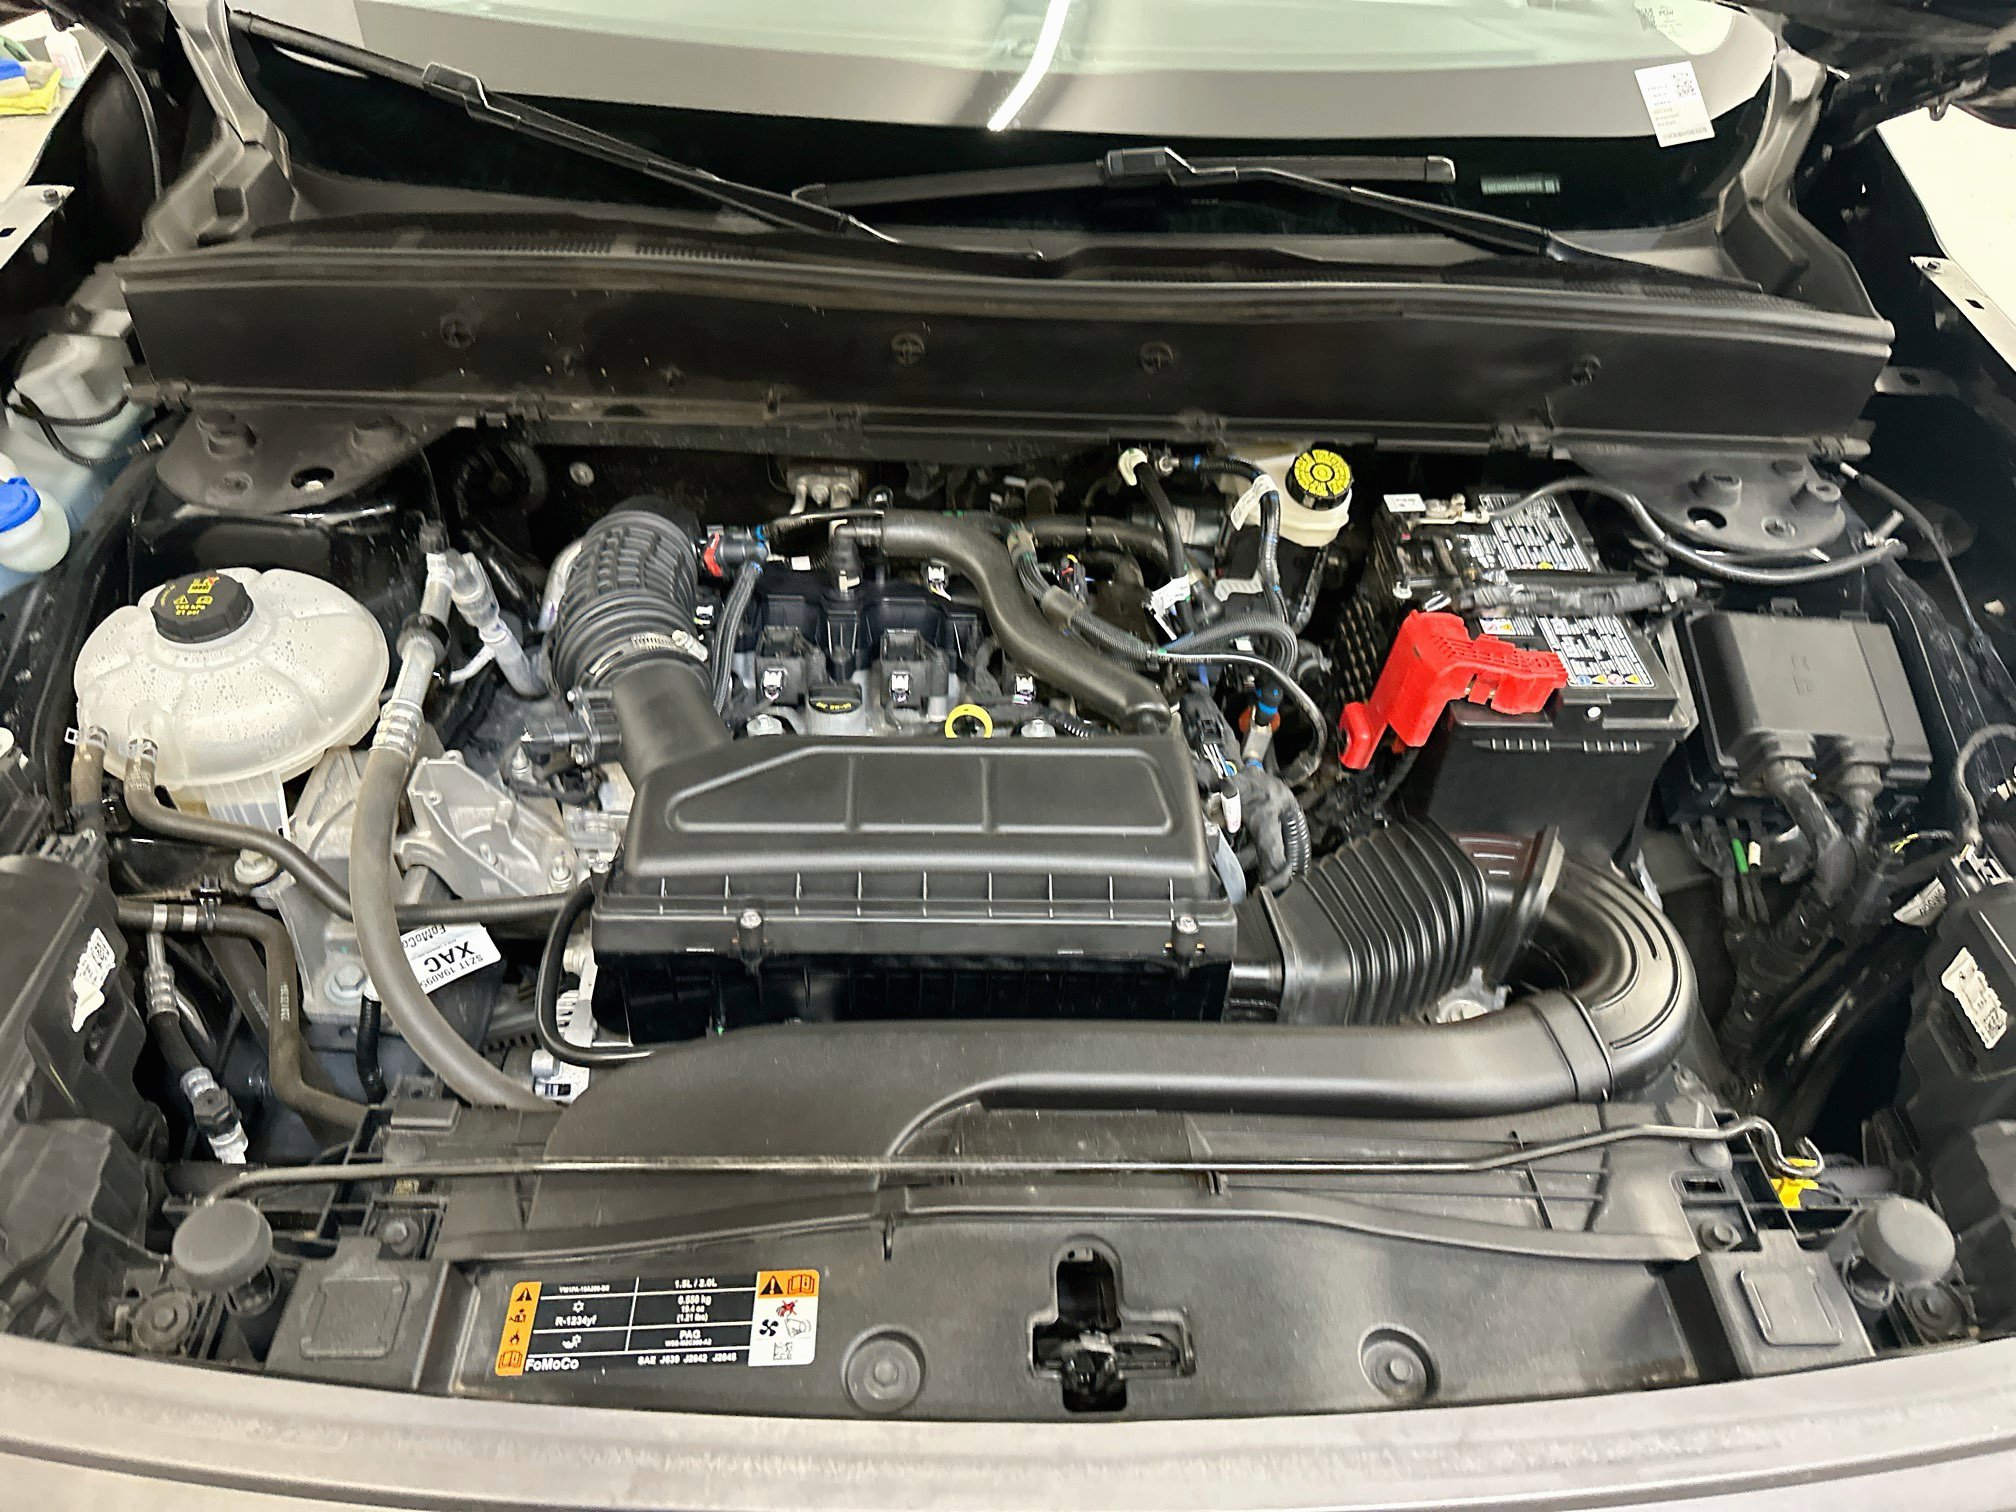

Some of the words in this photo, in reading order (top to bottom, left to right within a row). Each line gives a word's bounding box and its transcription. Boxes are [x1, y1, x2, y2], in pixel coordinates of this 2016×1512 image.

[423, 940, 475, 973] XAC
[701, 1294, 712, 1306] kg
[525, 1357, 580, 1371] FoMoCo
